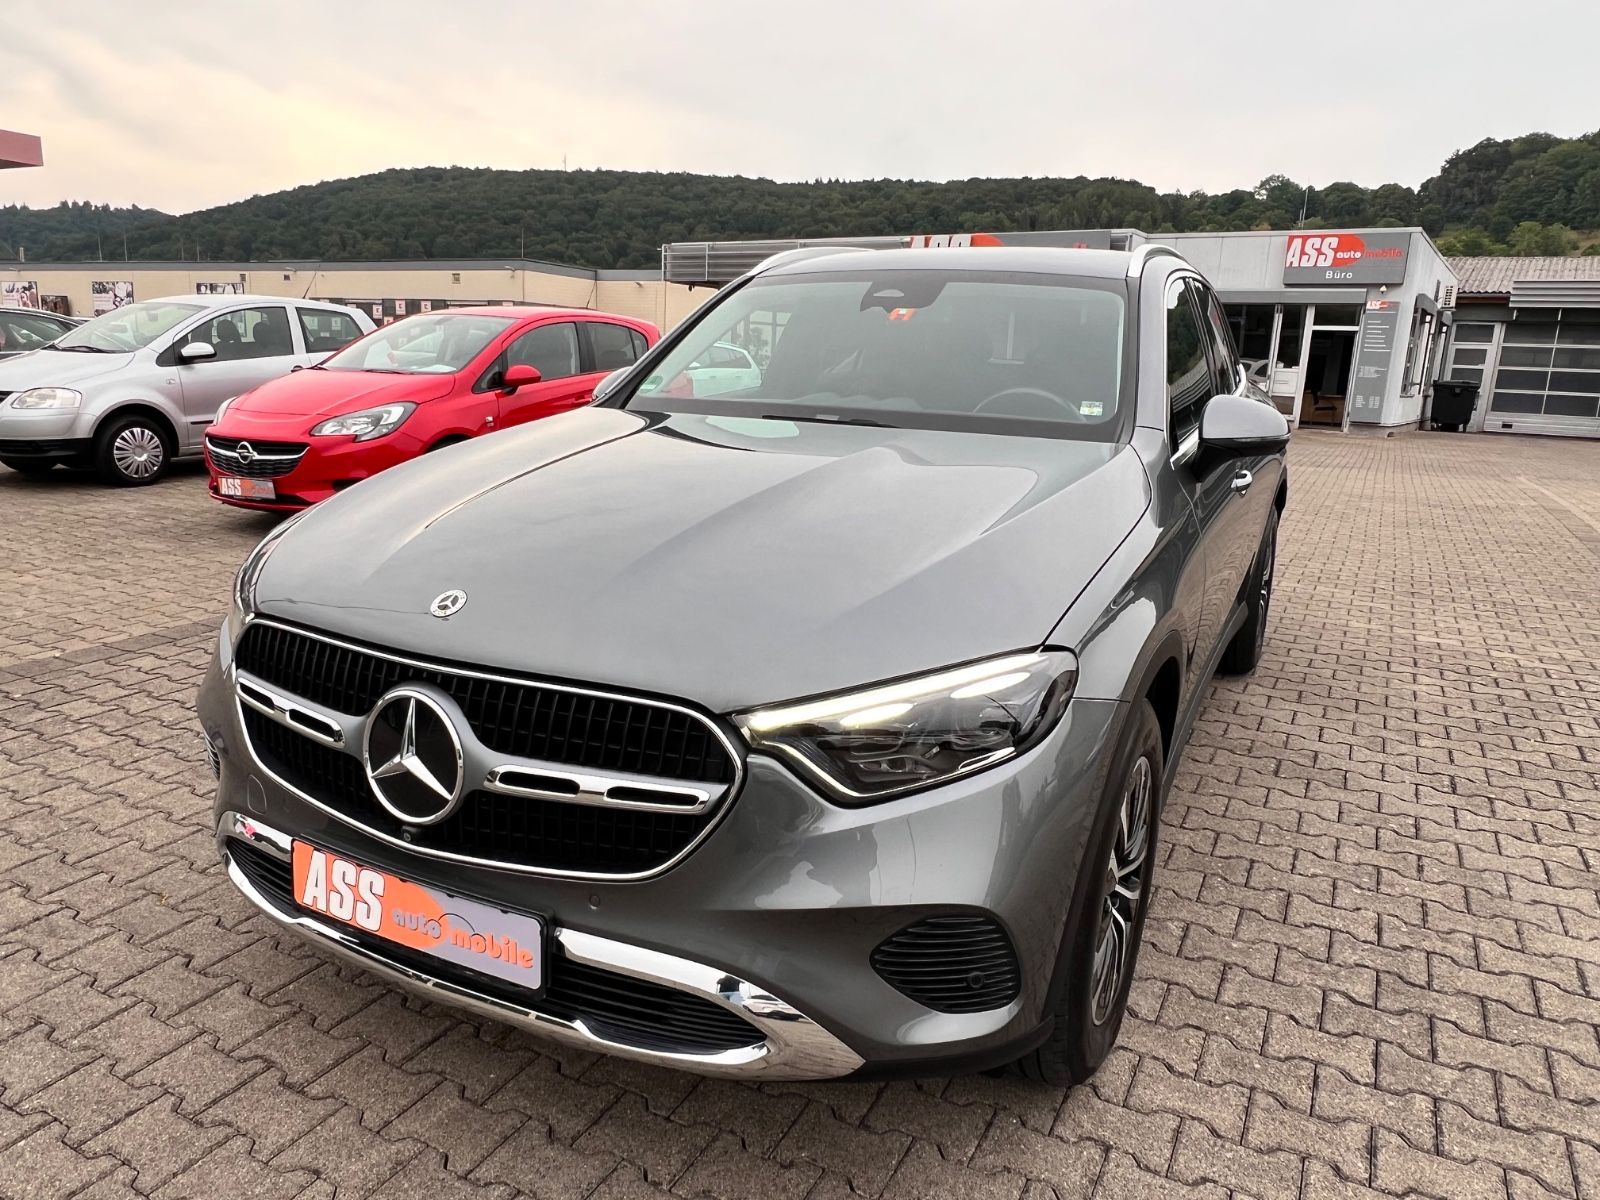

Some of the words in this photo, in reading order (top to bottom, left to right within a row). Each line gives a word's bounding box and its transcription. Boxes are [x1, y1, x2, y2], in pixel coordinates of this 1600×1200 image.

[1286, 237, 1339, 267] ASS
[1336, 250, 1361, 259] auto
[1325, 270, 1353, 279] Büro
[221, 477, 241, 495] ASS
[303, 849, 386, 932] ASS
[392, 908, 442, 940] auto
[450, 927, 534, 969] mobile
